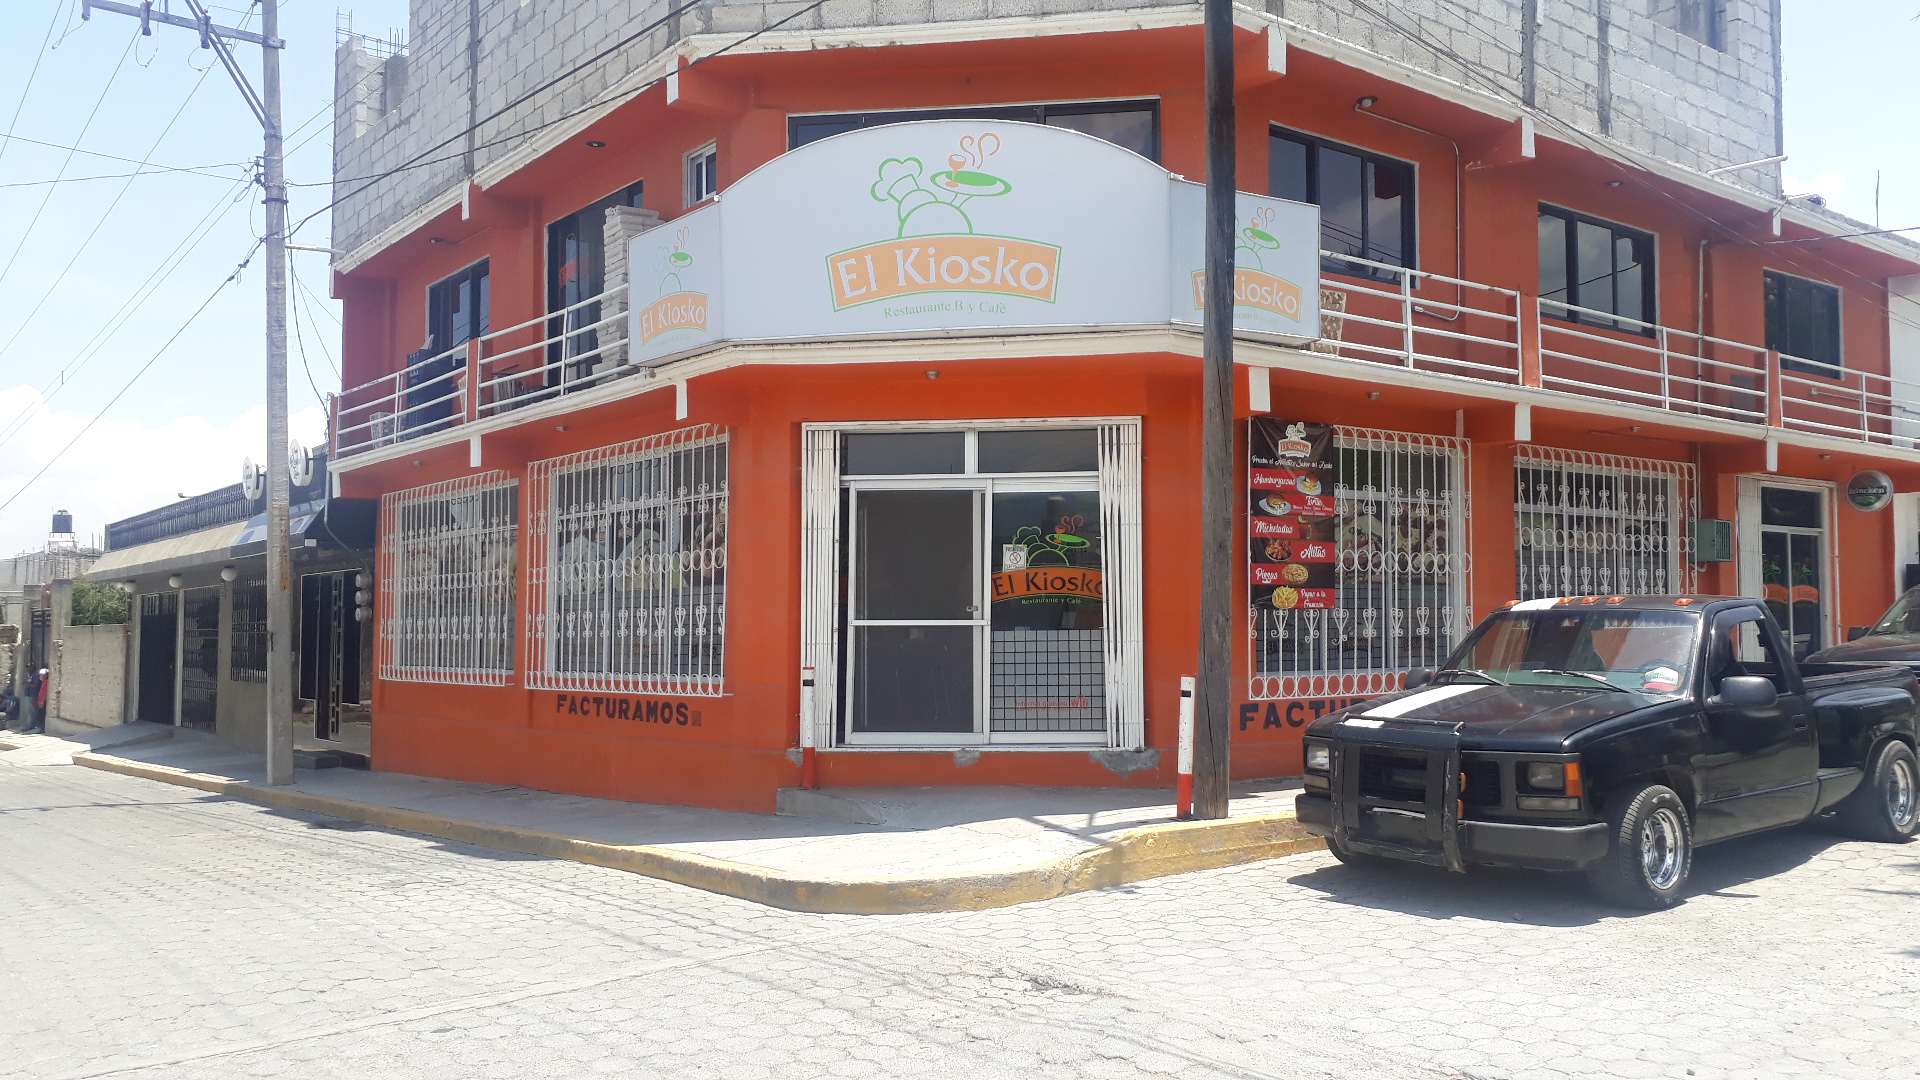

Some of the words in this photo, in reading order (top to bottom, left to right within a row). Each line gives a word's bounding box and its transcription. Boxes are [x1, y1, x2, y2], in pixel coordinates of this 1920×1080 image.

[836, 254, 878, 298] El
[895, 246, 1049, 290] Kiosko
[641, 310, 654, 337] El
[658, 298, 705, 328] Kiosko
[883, 301, 951, 318] Restaurante
[968, 303, 975, 314] y
[979, 301, 1007, 314] Café
[1254, 473, 1295, 487] Hamburguesas
[1254, 520, 1293, 533] Micheladas
[1301, 543, 1326, 558] Alitas
[1256, 567, 1278, 583] Pizzas
[992, 574, 1015, 596] El
[1021, 597, 1059, 605] Restaurante
[1066, 597, 1082, 605] Café
[1301, 589, 1315, 599] Papas
[556, 694, 689, 726] FACTURAMOS
